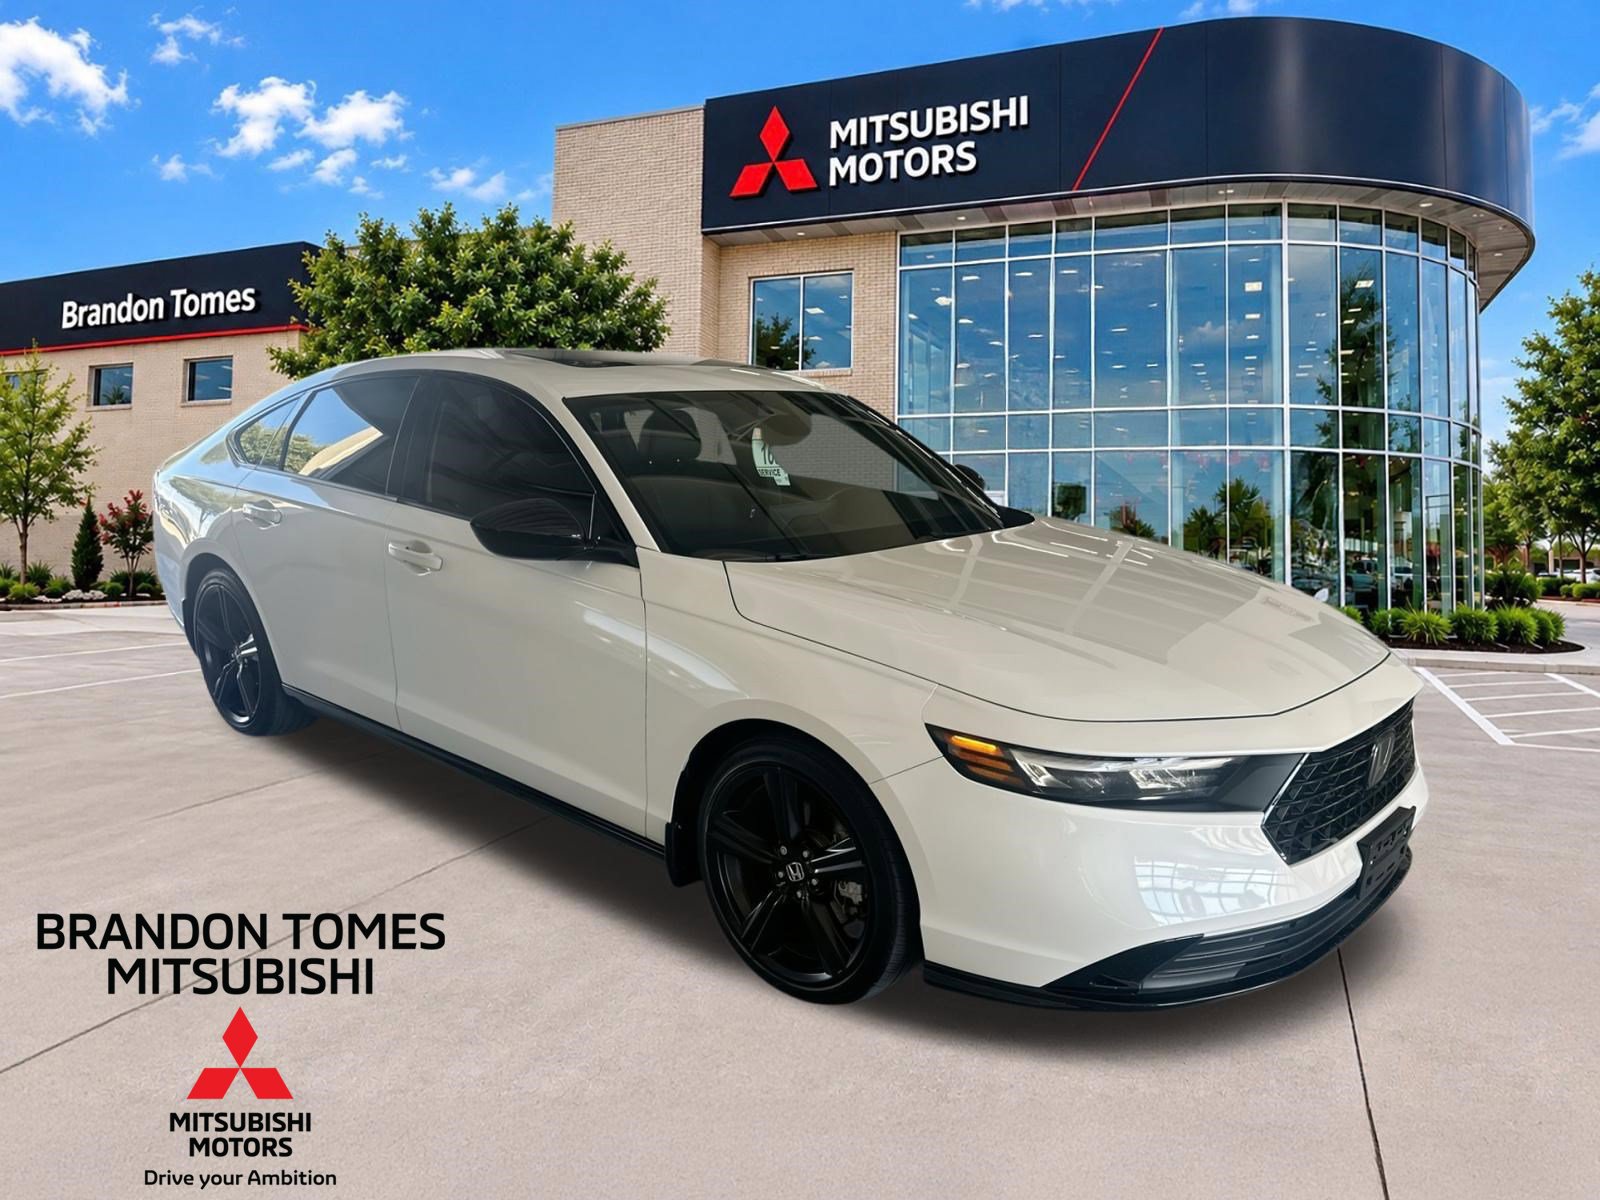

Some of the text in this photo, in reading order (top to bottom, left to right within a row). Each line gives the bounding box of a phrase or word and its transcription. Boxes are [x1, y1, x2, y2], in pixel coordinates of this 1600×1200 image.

[829, 95, 1029, 149] MITSUBISHI
[829, 141, 978, 187] MOTORS
[62, 288, 256, 329] Brandon Tomes
